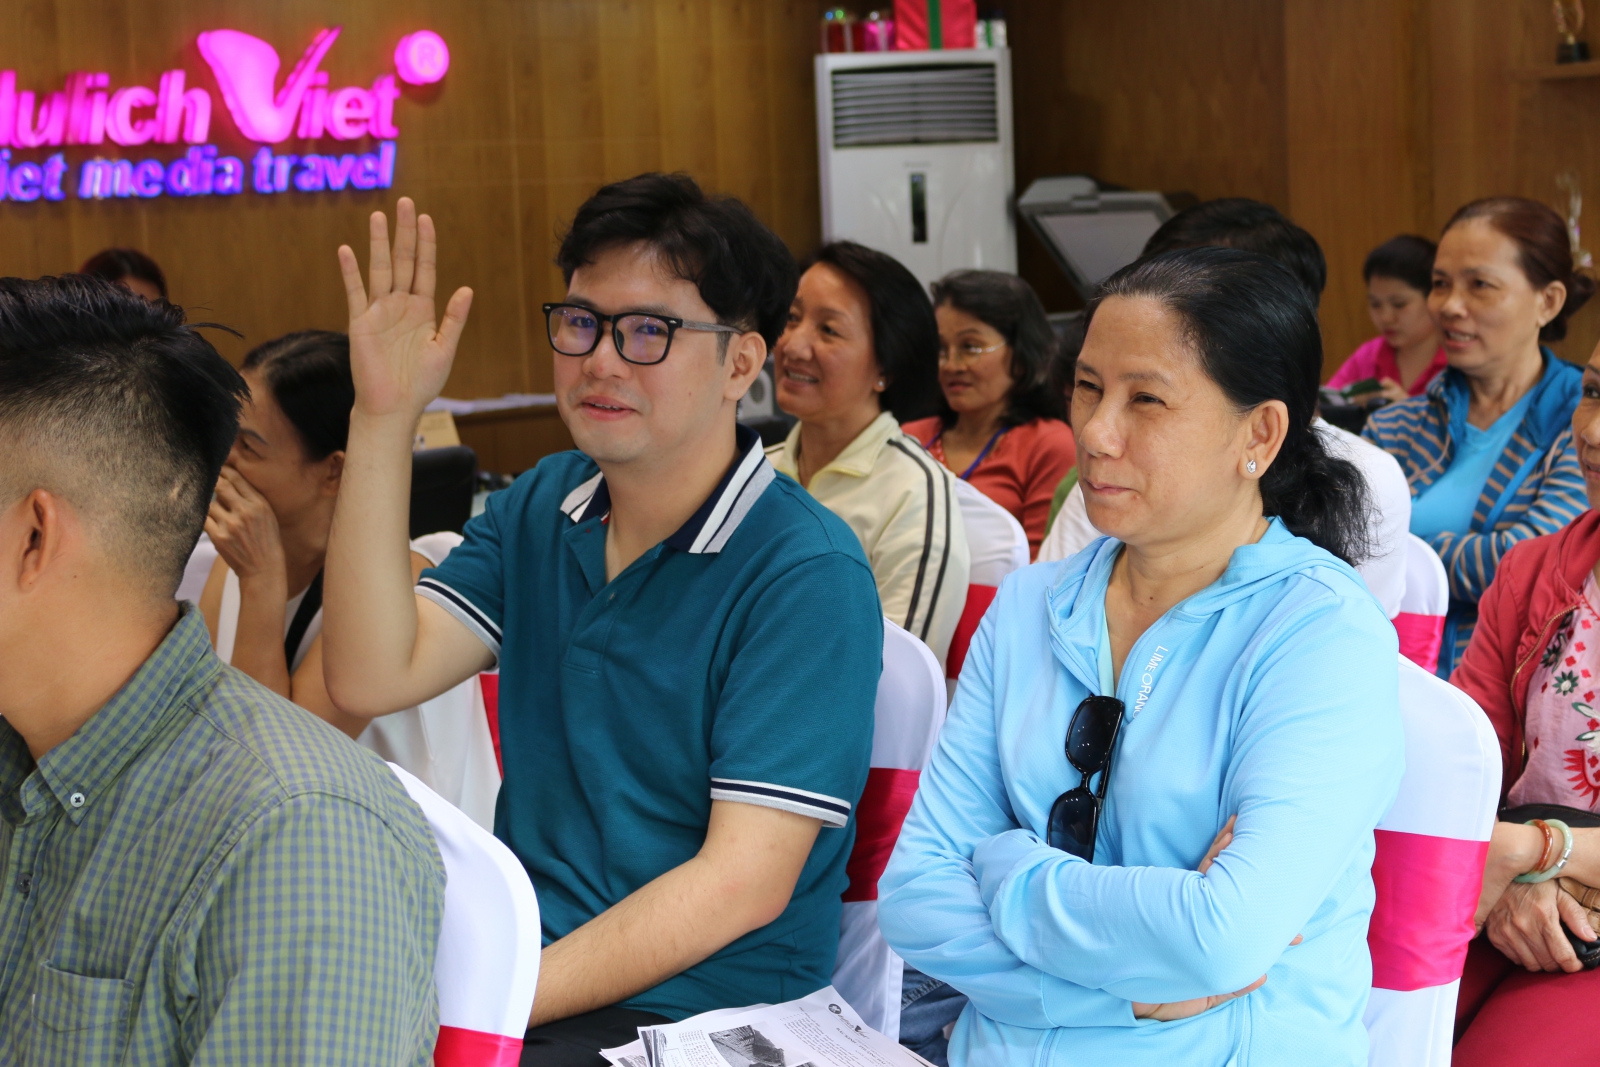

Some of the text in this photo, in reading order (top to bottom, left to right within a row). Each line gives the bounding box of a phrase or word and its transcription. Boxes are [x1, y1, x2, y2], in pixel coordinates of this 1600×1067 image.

[197, 25, 400, 142] Viet
[78, 144, 244, 199] media
[252, 140, 396, 194] travel
[1144, 645, 1169, 673] LIME
